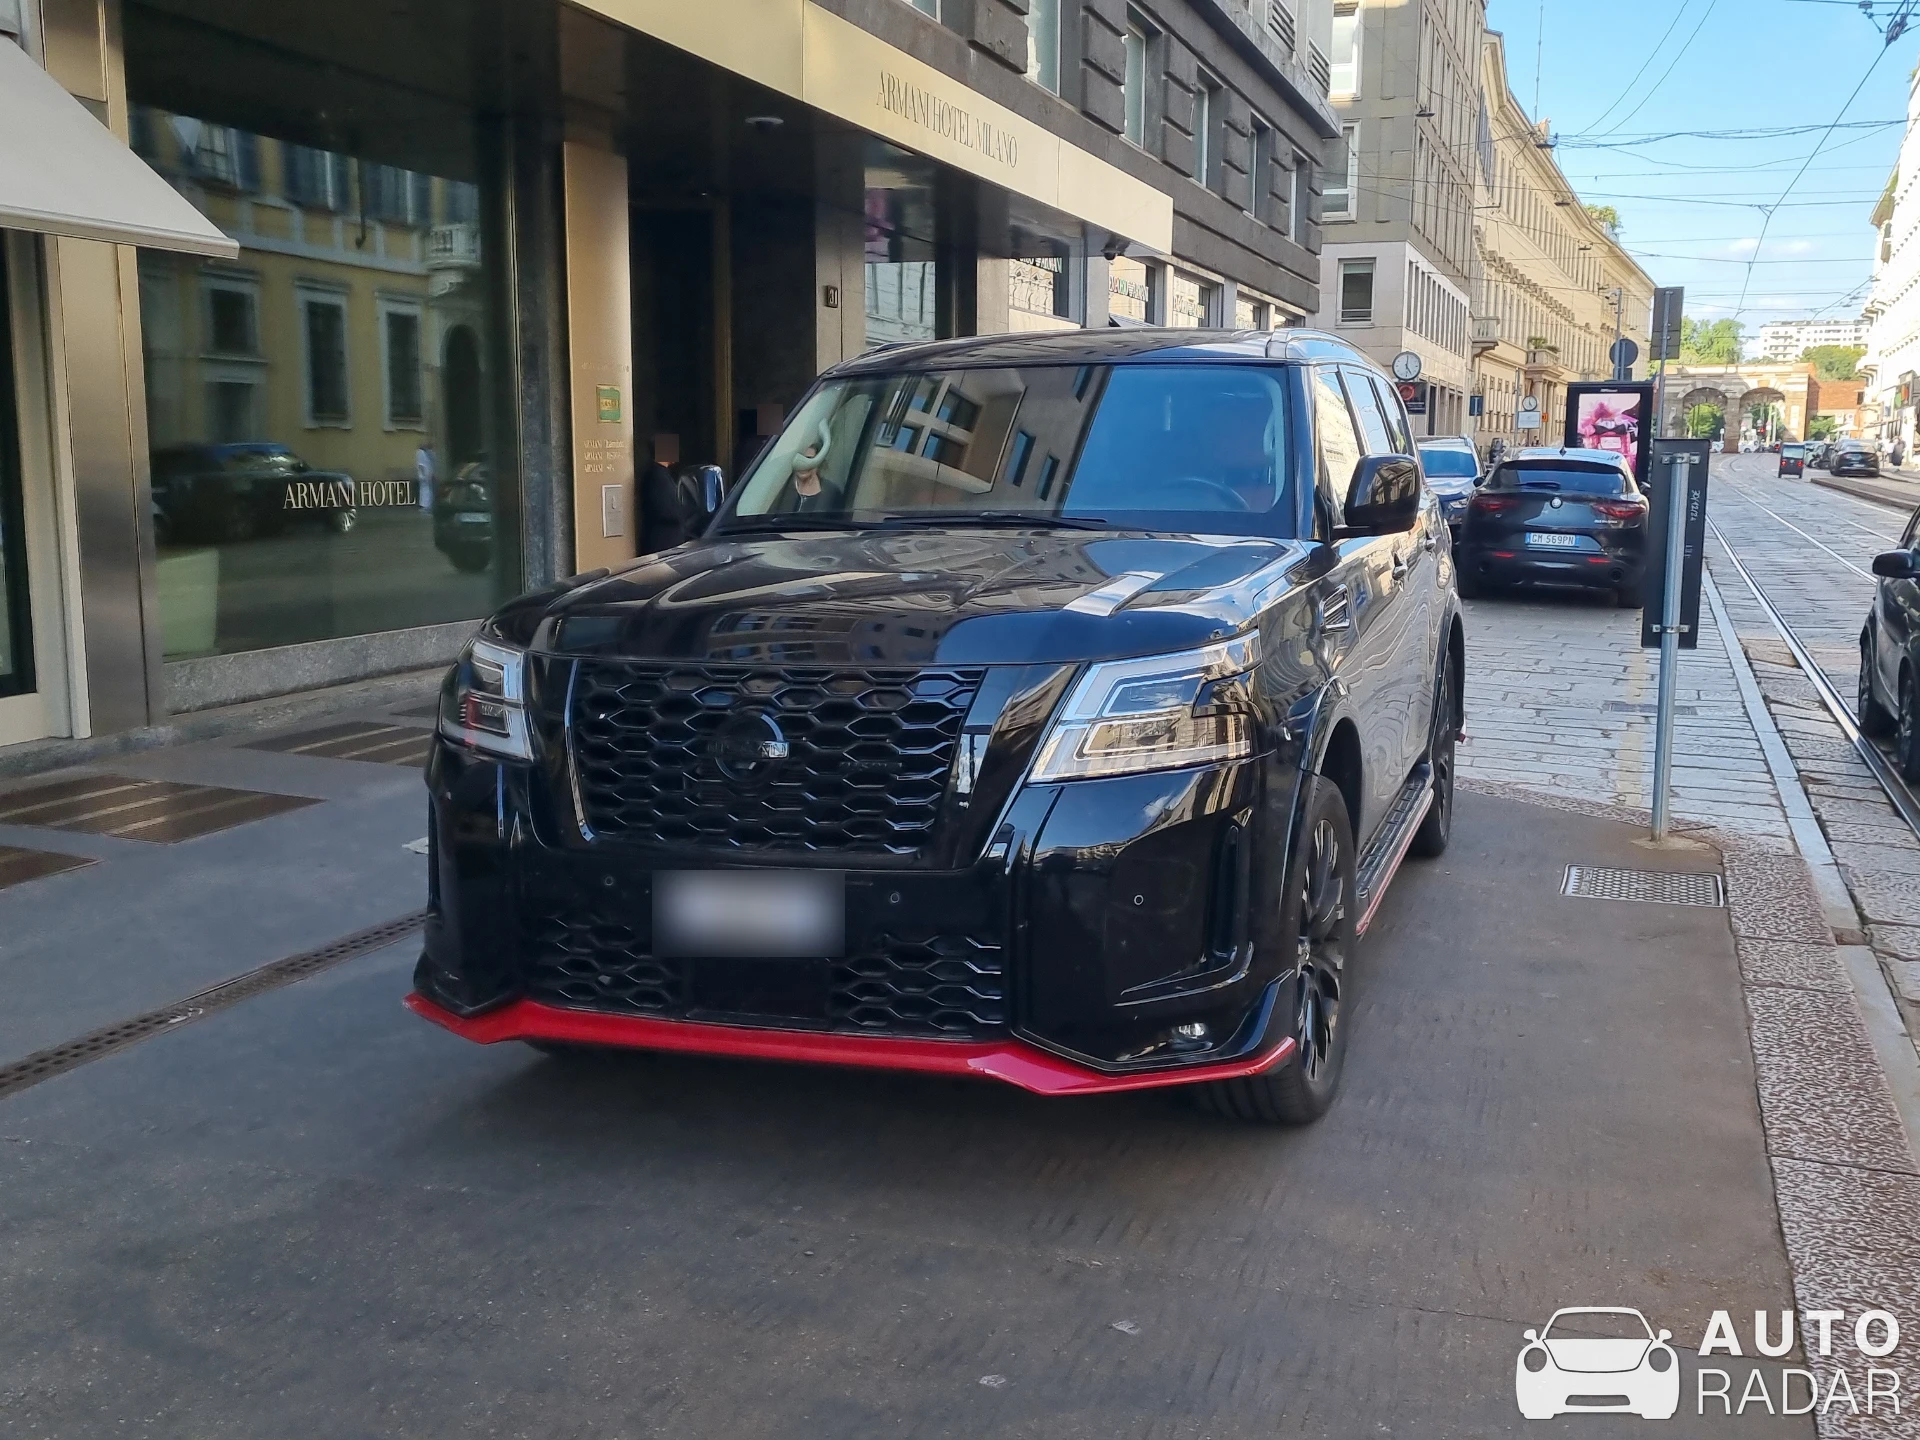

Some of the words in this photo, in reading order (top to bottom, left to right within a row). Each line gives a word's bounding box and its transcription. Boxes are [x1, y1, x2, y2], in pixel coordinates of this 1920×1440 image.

[876, 70, 929, 128] ARMANI
[933, 96, 973, 148] HOTEL
[976, 118, 1017, 168] MILANO
[829, 289, 838, 305] 31
[282, 481, 356, 509] ARMANI
[360, 480, 416, 507] HOTEL
[1532, 534, 1542, 543] GM
[1546, 535, 1574, 545] 569PN
